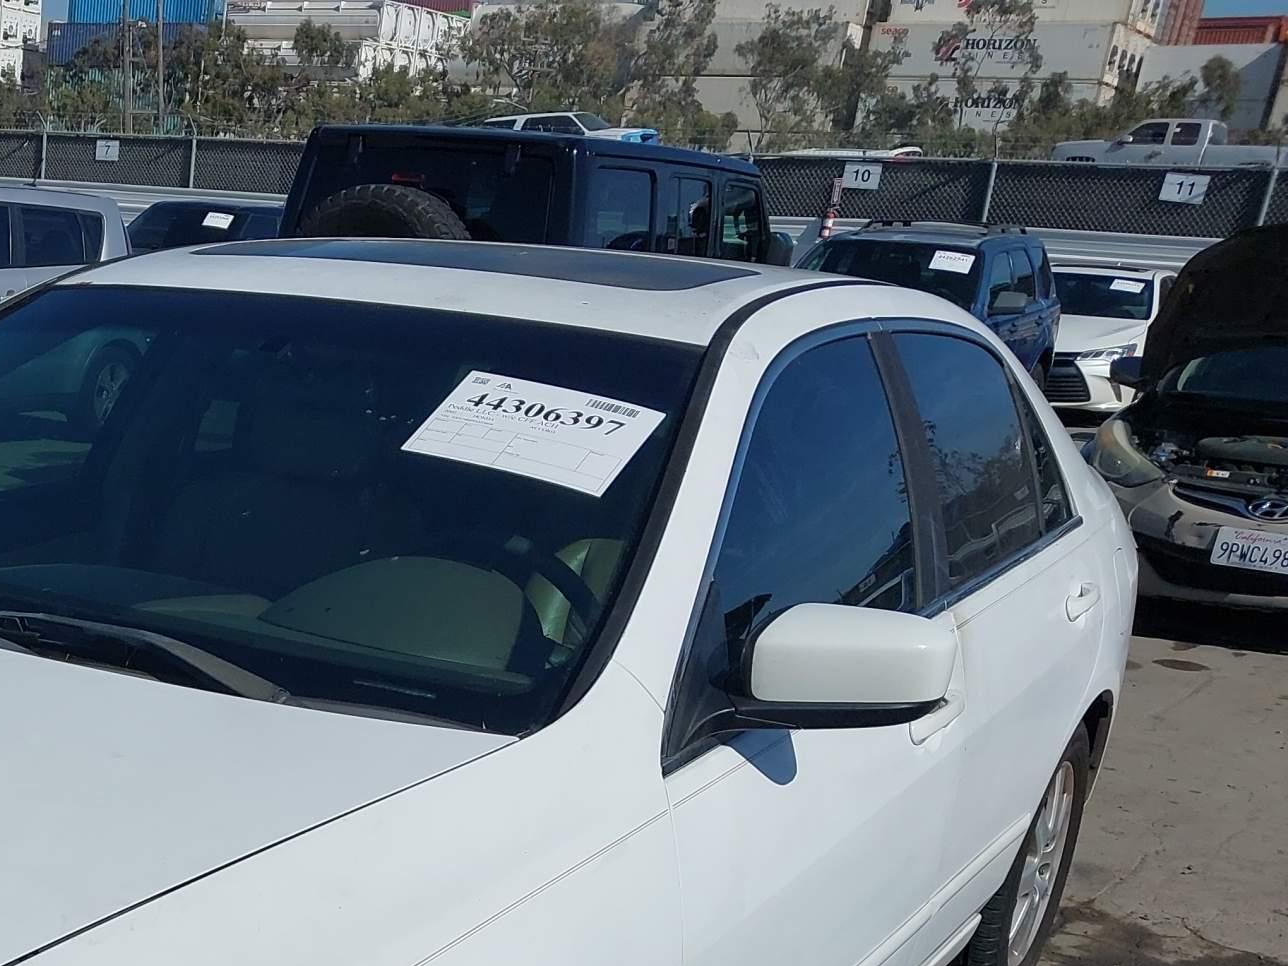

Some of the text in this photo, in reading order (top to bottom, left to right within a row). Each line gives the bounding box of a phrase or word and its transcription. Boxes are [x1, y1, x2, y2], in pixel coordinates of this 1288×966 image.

[965, 38, 1039, 50] HORIZON
[104, 144, 111, 155] 7
[852, 168, 871, 183] 10
[1176, 180, 1196, 196] 11
[466, 392, 627, 436] 44306397
[1216, 541, 1288, 568] 9PWC498
